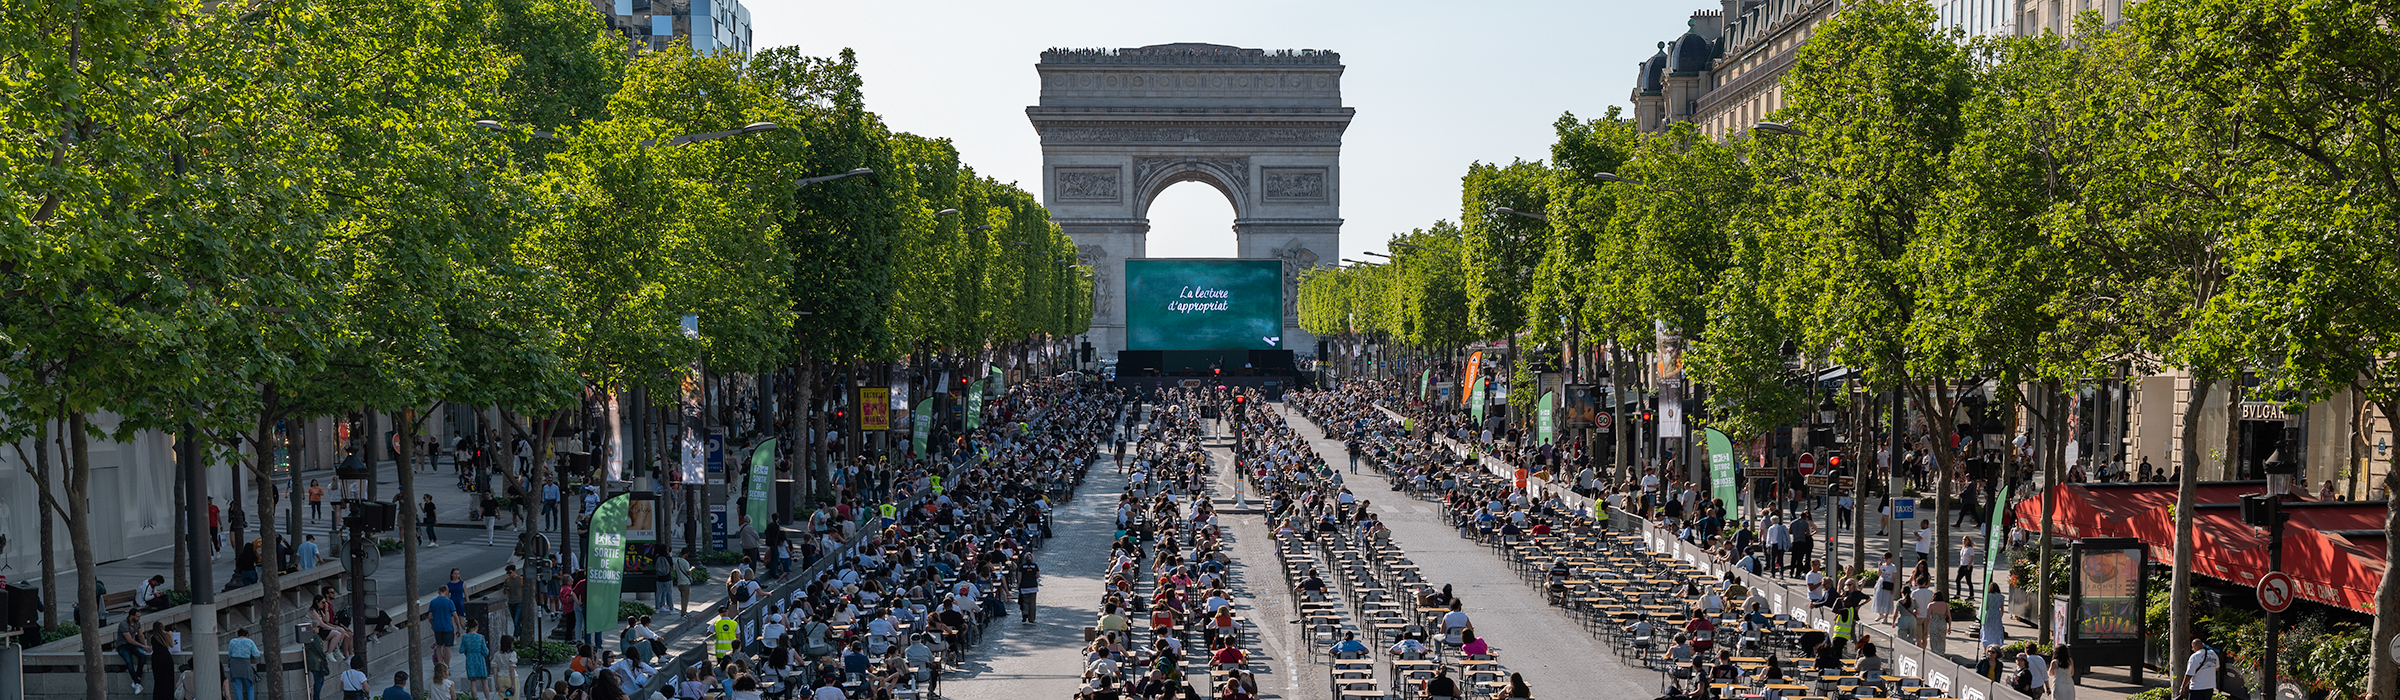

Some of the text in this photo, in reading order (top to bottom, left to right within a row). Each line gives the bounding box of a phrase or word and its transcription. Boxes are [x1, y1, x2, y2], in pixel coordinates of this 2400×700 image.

[1179, 285, 1229, 299] La lecture
[1167, 300, 1229, 314] d'appropriat
[2242, 404, 2285, 419] BVLGAR
[1895, 505, 1914, 513] TAXIS
[594, 547, 620, 559] SORTIE
[600, 558, 610, 569] DE
[589, 569, 621, 580] SECOURS
[2304, 581, 2316, 596] DES
[2317, 584, 2341, 603] CHAMPS
